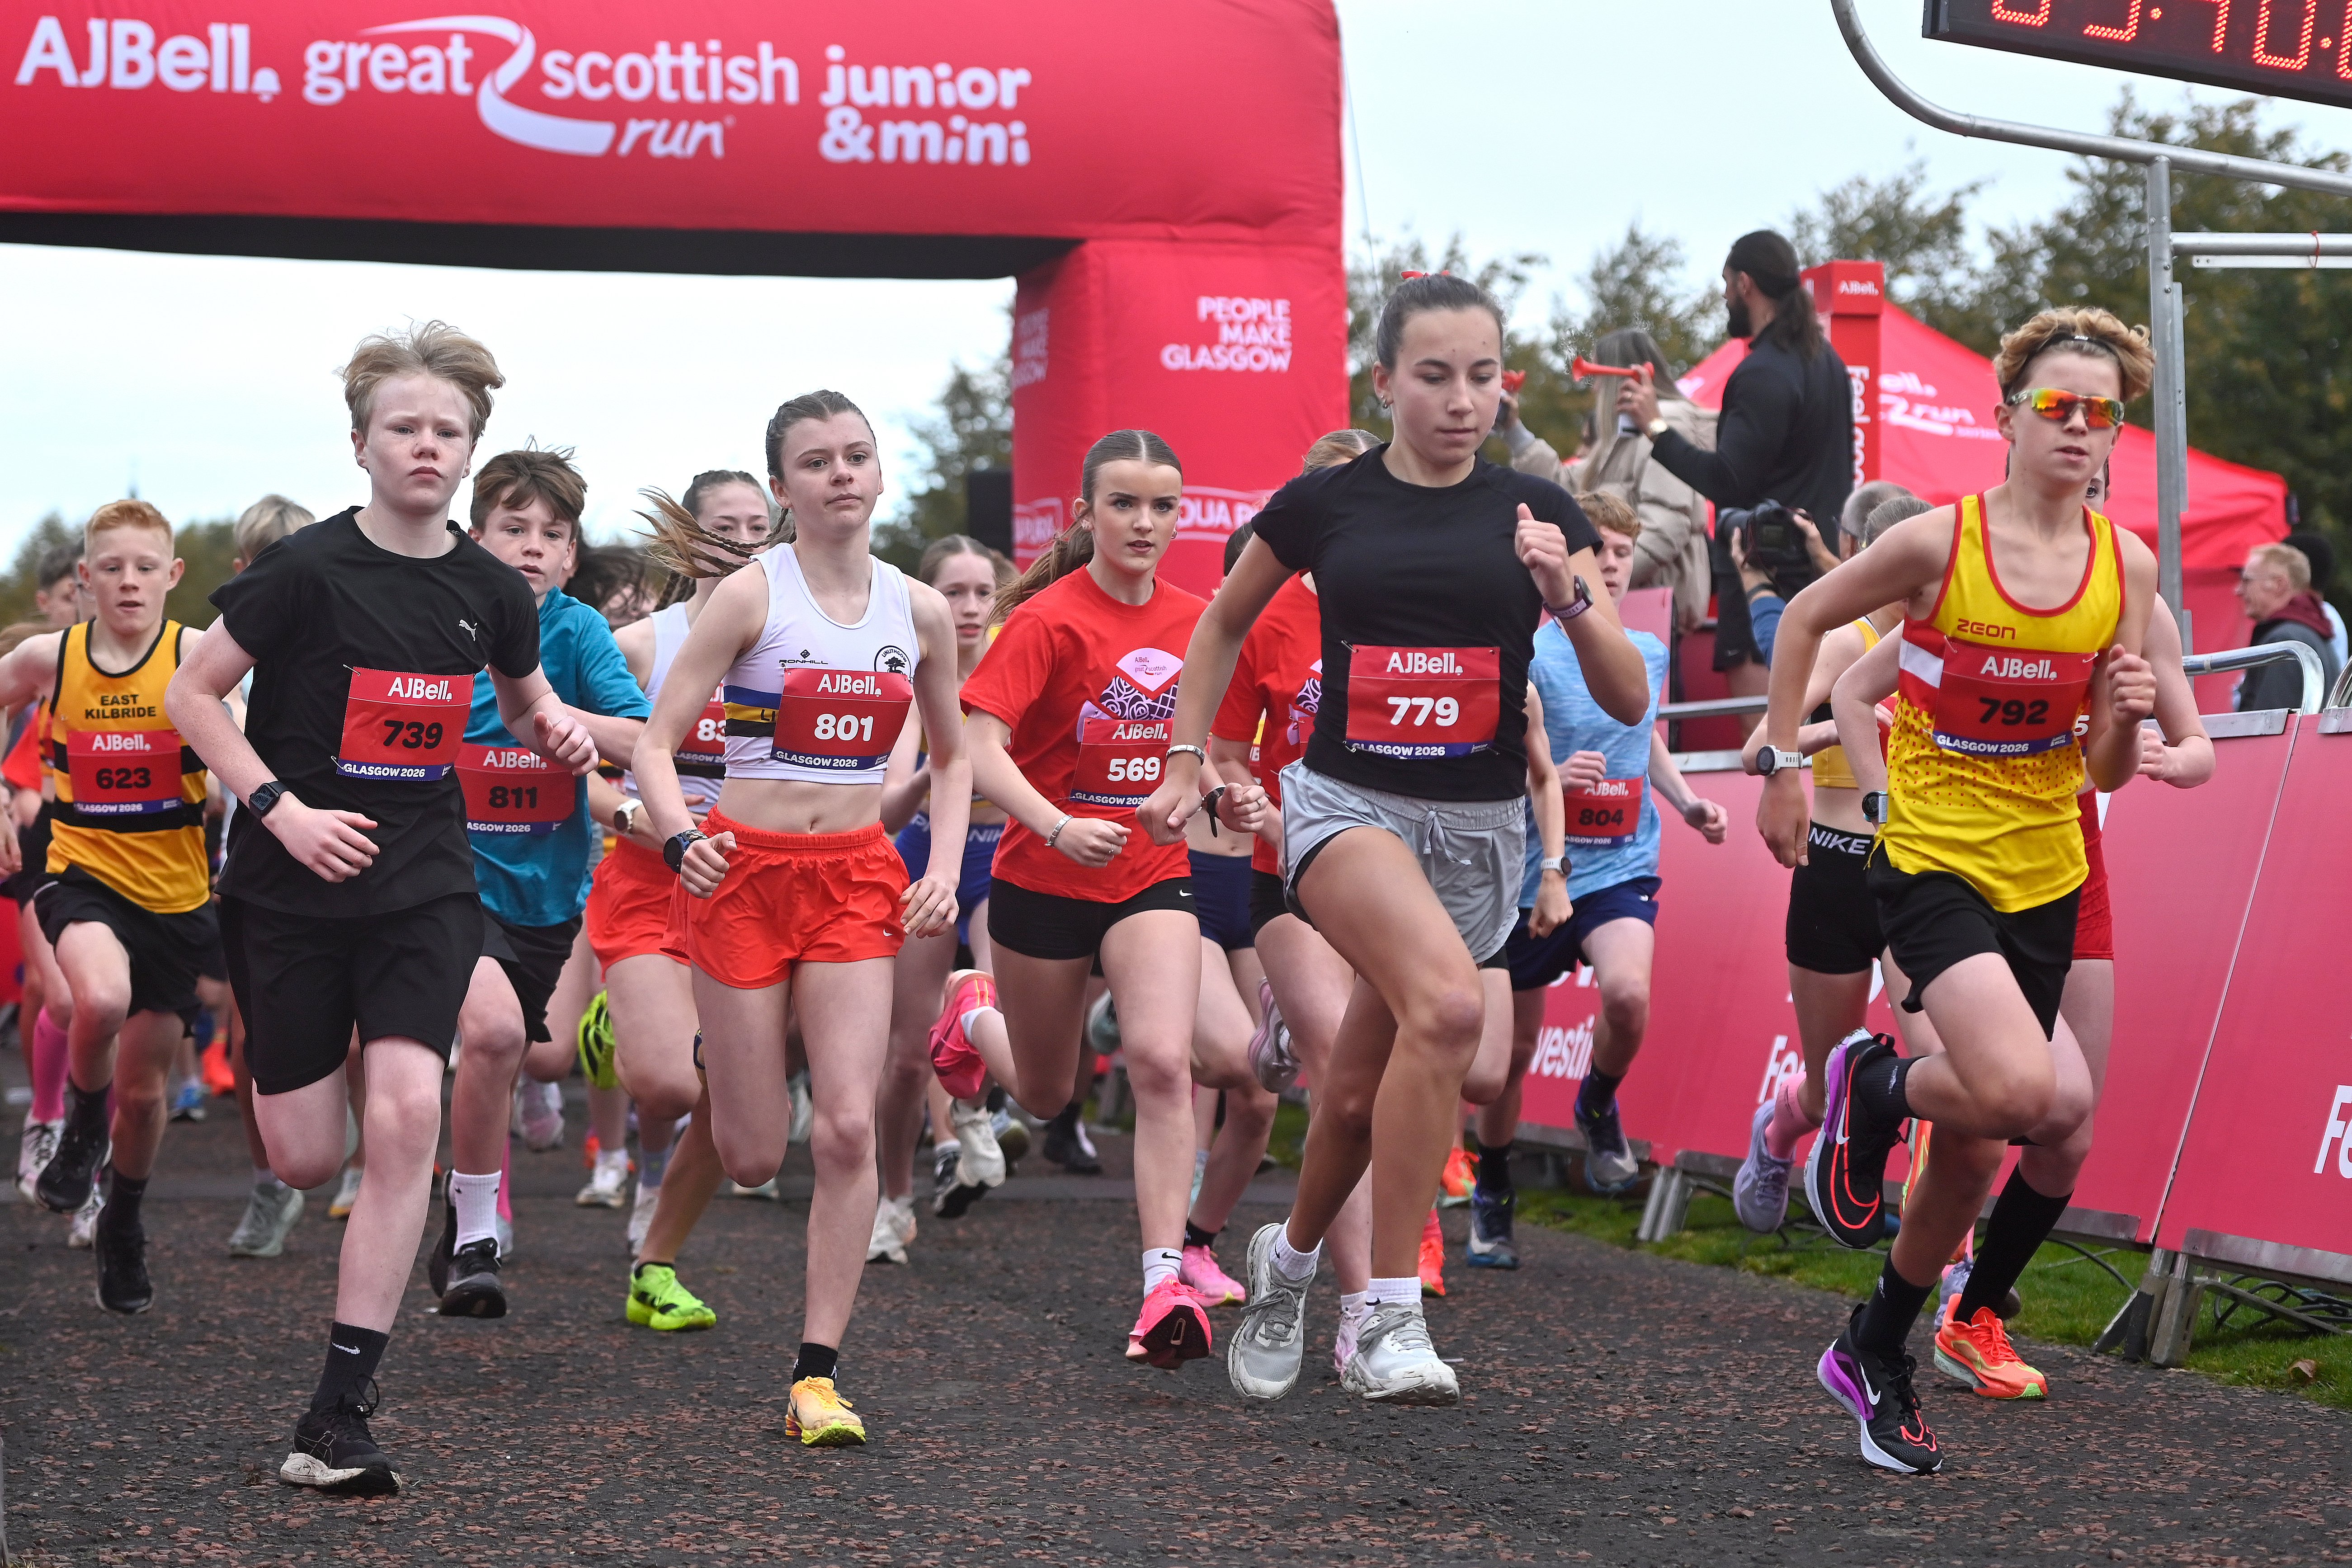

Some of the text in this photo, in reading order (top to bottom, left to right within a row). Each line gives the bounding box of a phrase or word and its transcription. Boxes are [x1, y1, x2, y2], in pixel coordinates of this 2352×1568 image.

[302, 33, 801, 106] great scottish
[819, 43, 1033, 109] junior
[616, 118, 725, 159] run
[1197, 296, 1291, 324] PEOPLE
[1219, 322, 1292, 346] MAKE
[1160, 344, 1292, 373] GLASGOW
[100, 694, 139, 706] EAST
[1387, 697, 1459, 726] 779
[1979, 697, 2049, 726] 792
[85, 706, 157, 719] KILBRIDE
[383, 720, 443, 749] 739
[814, 713, 874, 742] 801
[1352, 743, 1446, 756] GLASGOW 2026
[1937, 735, 2030, 753] GLASGOW 2026
[343, 763, 426, 777] GLASGOW 2026
[776, 750, 858, 768] GLASGOW 2026
[1108, 756, 1160, 782] 569
[96, 767, 151, 790] 623
[489, 786, 538, 809] 811
[1075, 792, 1126, 805] GLASGOW
[505, 824, 532, 833] 2026
[1579, 808, 1624, 826] 804
[1809, 827, 1871, 856] NIKE
